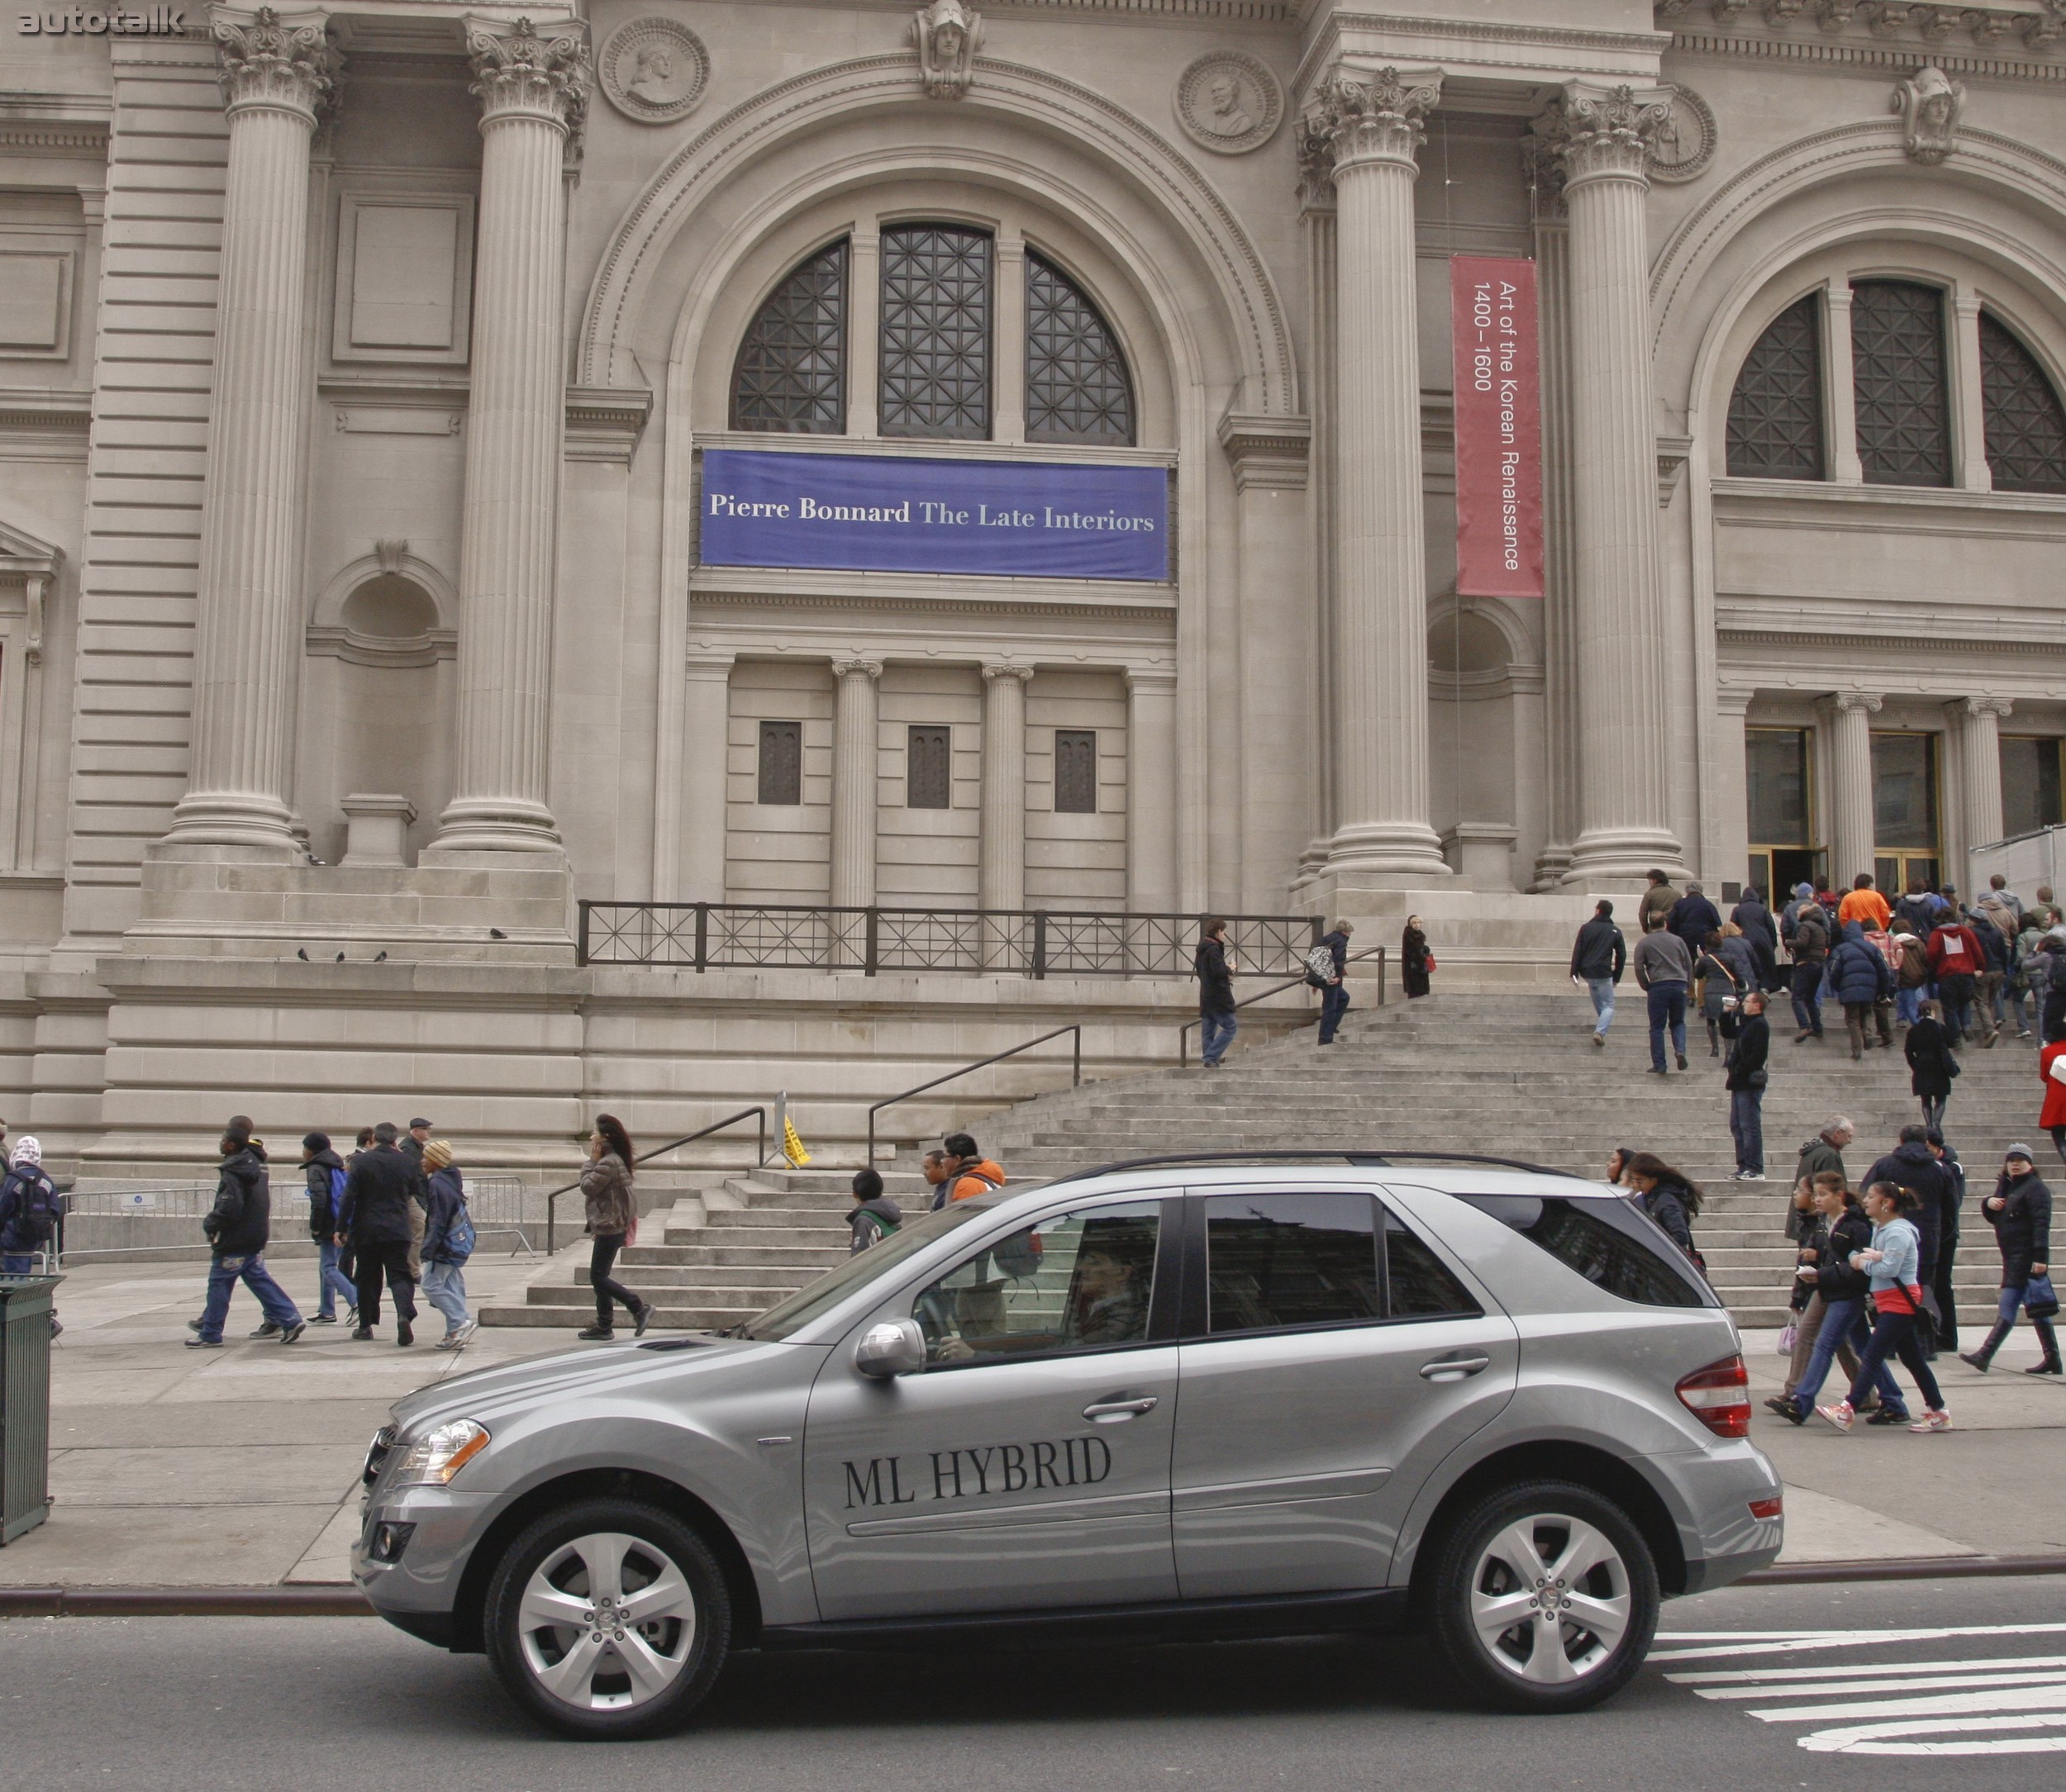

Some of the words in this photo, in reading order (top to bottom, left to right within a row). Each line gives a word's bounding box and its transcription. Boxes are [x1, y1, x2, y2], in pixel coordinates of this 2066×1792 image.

[1499, 281, 1517, 311] Art
[1499, 316, 1517, 336] of
[1499, 341, 1517, 373] the
[1500, 379, 1518, 444] Korean
[708, 493, 790, 519] Pierre
[798, 497, 911, 523] Bonnard
[919, 501, 969, 525] The
[978, 504, 1035, 528] Late
[1043, 506, 1155, 532] Interiors
[1502, 452, 1521, 571] Renaissance
[841, 1457, 916, 1509] ML
[928, 1436, 1112, 1500] HYBRID
